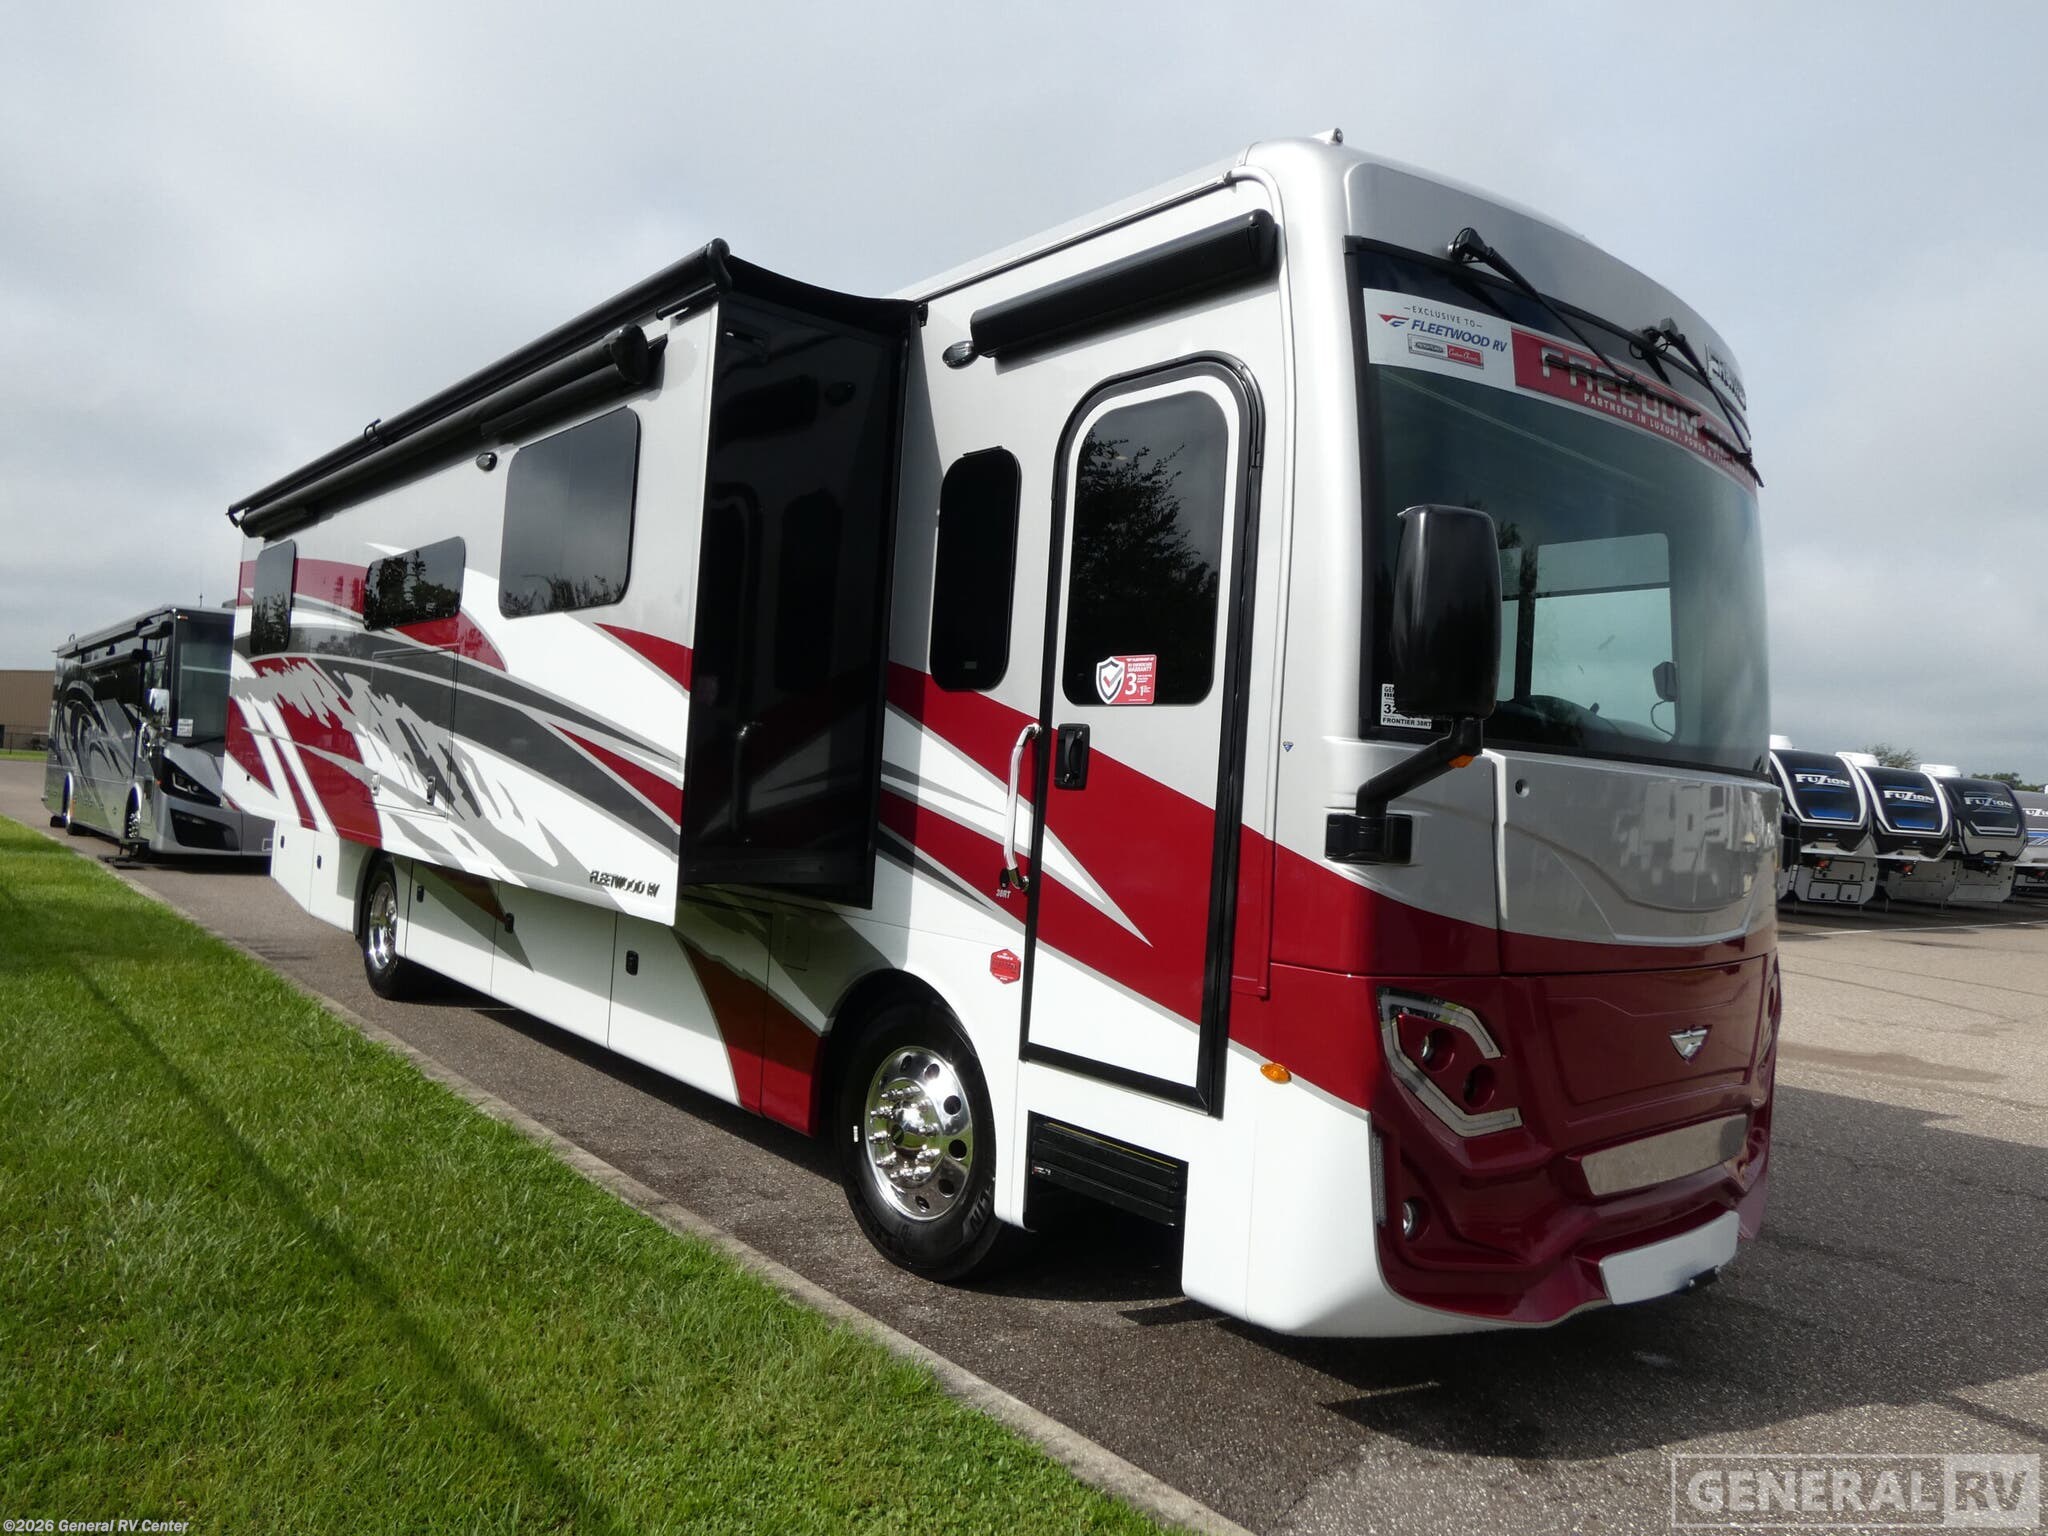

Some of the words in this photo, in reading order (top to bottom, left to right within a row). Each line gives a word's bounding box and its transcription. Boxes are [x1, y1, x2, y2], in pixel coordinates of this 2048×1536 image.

[1412, 305, 1461, 324] EXCLUSIVE
[1465, 318, 1475, 328] TO
[1411, 319, 1490, 347] FLEETWOOD
[1492, 339, 1508, 352] RV
[1584, 392, 1633, 419] PARTNERS
[1637, 413, 1646, 424] IN
[1125, 672, 1137, 695] 3
[1383, 718, 1415, 726] FRONTIER
[1794, 774, 1850, 788] FUZION
[1883, 790, 1935, 804] FUZION
[1964, 797, 2014, 809] FUZION
[589, 870, 645, 894] FLEETWOOD
[646, 882, 660, 898] RV
